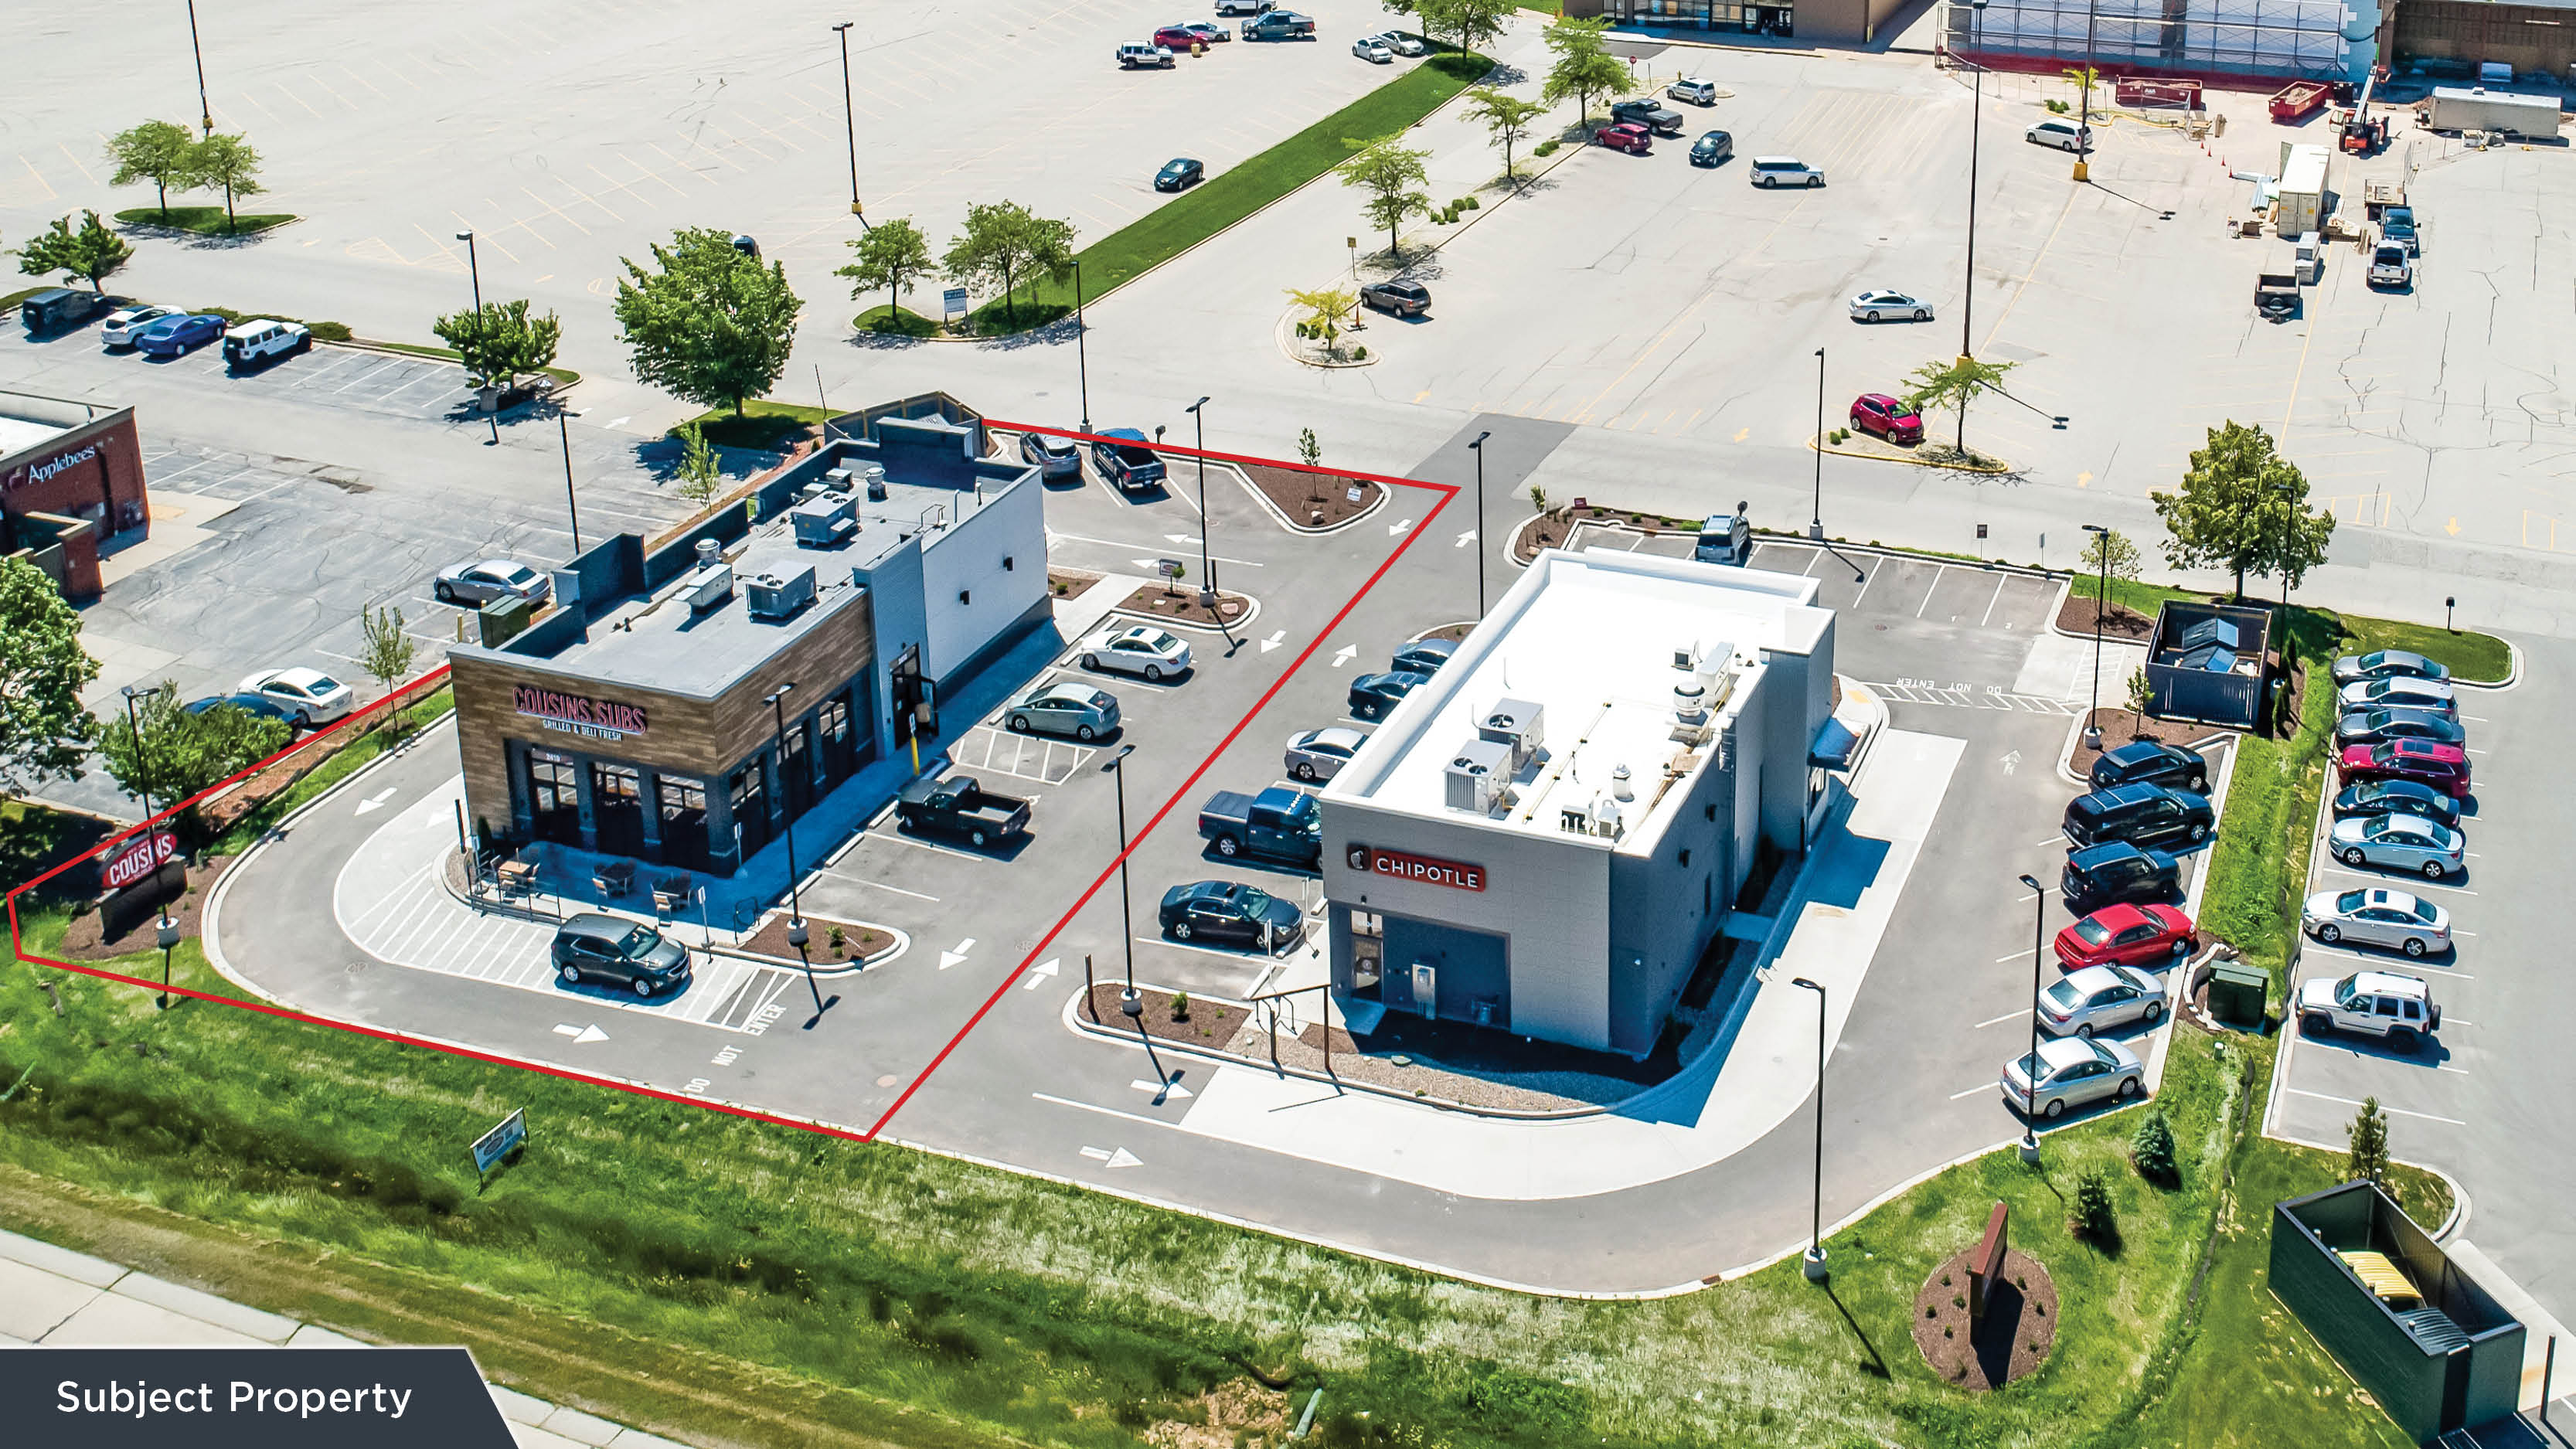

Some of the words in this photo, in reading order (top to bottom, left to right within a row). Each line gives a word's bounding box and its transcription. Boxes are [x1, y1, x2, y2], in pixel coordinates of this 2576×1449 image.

[1896, 677, 1935, 690] ENTER
[1948, 682, 1972, 692] NOT
[1986, 685, 2002, 694] DO
[512, 686, 592, 723] COUSINS
[596, 702, 647, 733] SUBS
[543, 719, 571, 733] GRILLED
[573, 726, 579, 734] &
[582, 726, 597, 737] DELI
[599, 730, 622, 742] FRESH
[110, 835, 172, 885] COUSINS
[1376, 858, 1479, 888] CHIPOTLE
[682, 1077, 710, 1094] DO
[711, 1044, 743, 1066] NOT
[742, 1004, 787, 1036] ENTER
